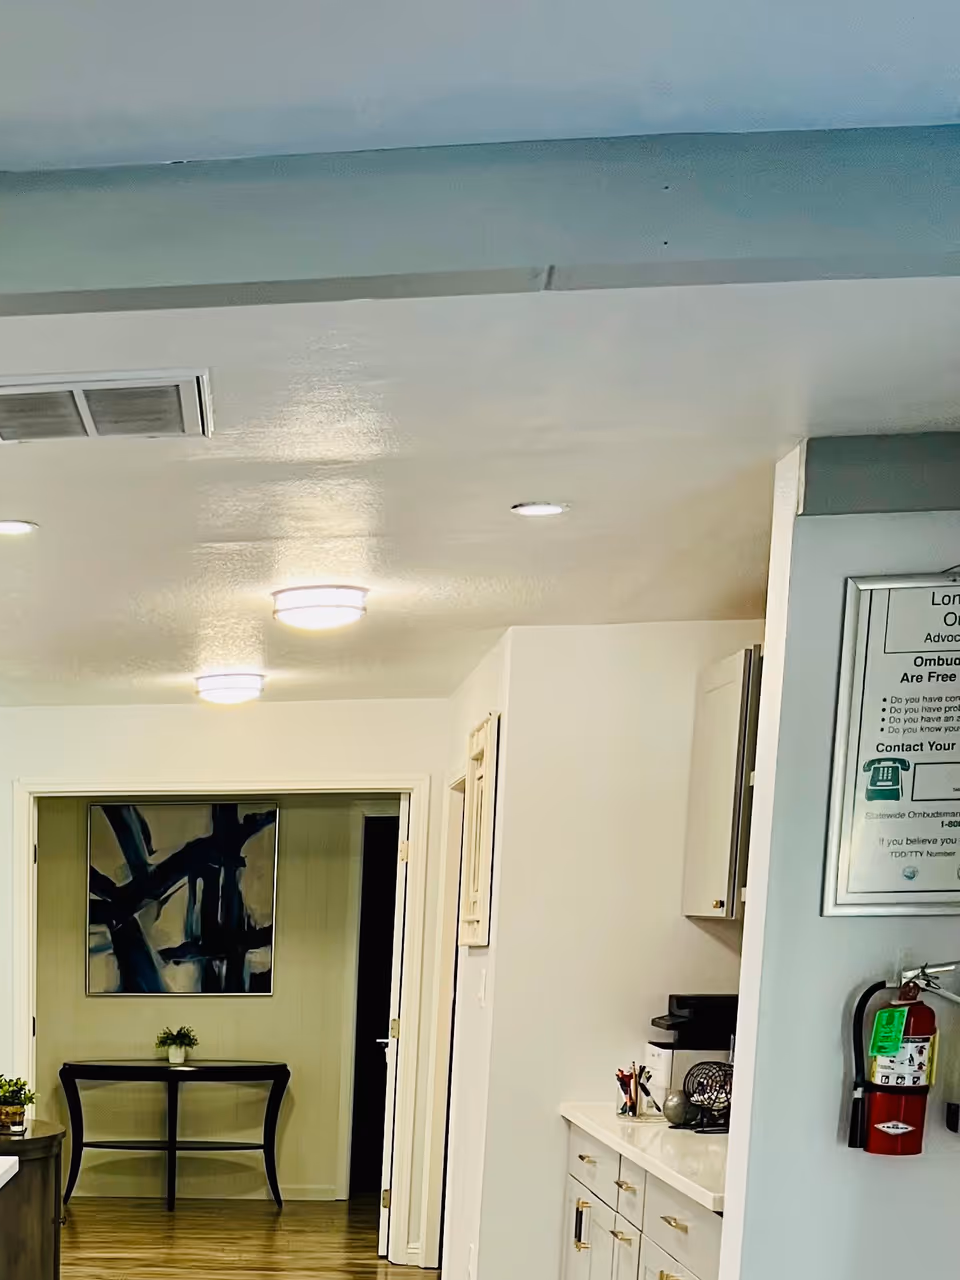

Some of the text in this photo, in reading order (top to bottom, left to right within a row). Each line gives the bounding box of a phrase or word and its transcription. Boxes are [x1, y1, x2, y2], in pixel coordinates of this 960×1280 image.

[944, 611, 960, 627] O
[900, 671, 957, 683] Are Free
[891, 696, 902, 704] Do
[905, 697, 920, 705] you
[890, 706, 901, 714] Do
[904, 707, 919, 715] you
[889, 716, 900, 724] Do
[903, 717, 918, 725] you
[921, 715, 941, 723] have
[888, 726, 899, 734] Do
[902, 727, 917, 735] you
[876, 741, 956, 753] Contact Your
[865, 811, 906, 819] Statewide
[879, 837, 885, 845] If
[887, 838, 903, 847] you
[906, 837, 938, 845] believe
[940, 837, 957, 846] you
